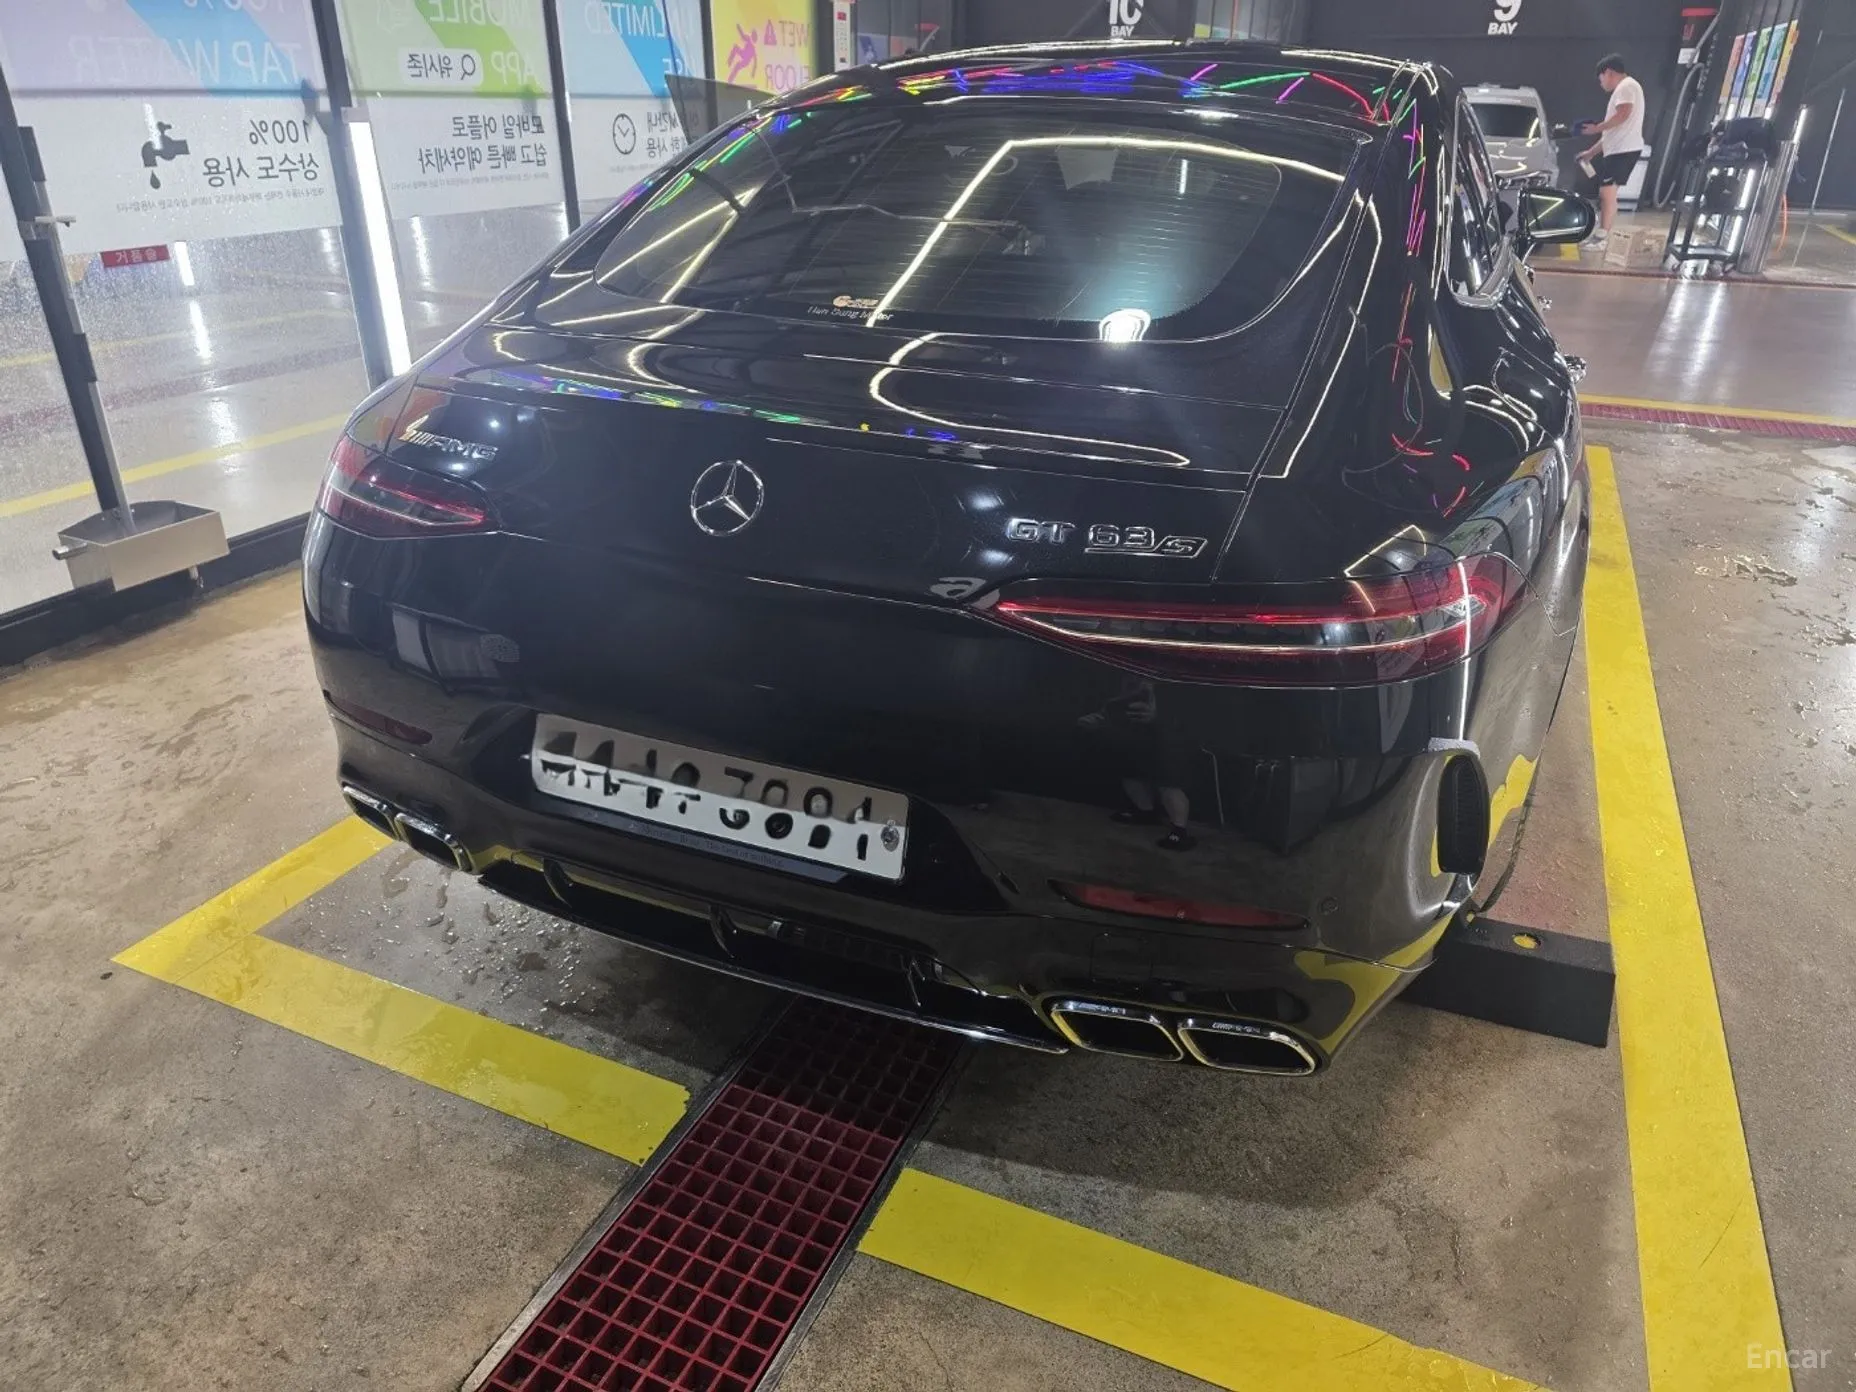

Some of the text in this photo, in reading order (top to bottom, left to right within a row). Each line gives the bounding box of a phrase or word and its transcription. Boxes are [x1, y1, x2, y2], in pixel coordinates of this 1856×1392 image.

[1110, 25, 1135, 37] BAY
[1488, 22, 1518, 35] BAY
[1006, 518, 1076, 544] GT
[1087, 523, 1156, 549] 63
